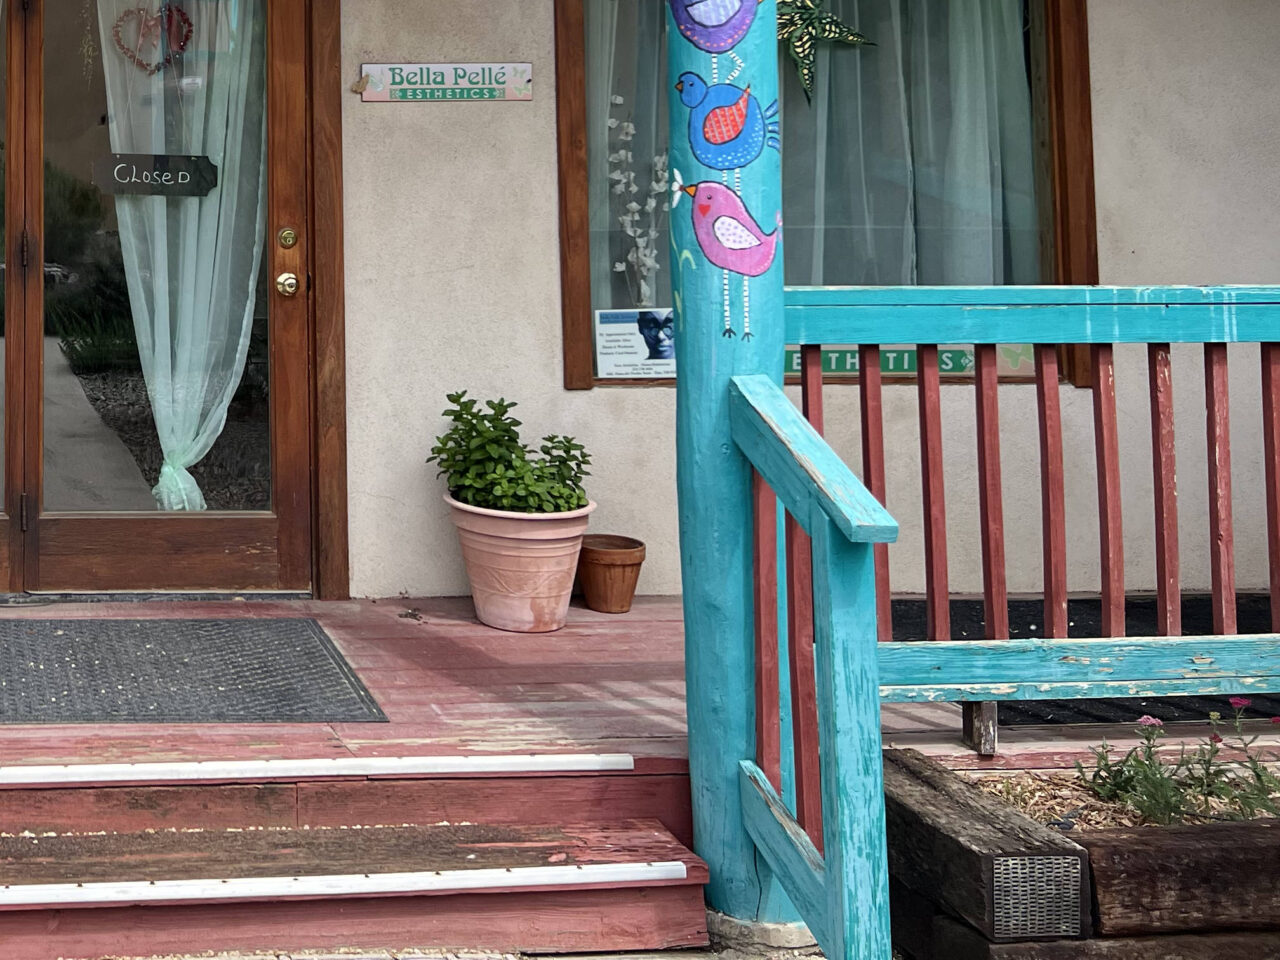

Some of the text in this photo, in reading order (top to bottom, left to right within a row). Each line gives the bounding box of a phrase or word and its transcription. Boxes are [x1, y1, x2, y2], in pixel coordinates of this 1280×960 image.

[388, 66, 507, 86] Bella Pellé
[406, 88, 490, 99] ESTHETICS
[791, 352, 954, 371] ETHTIS
